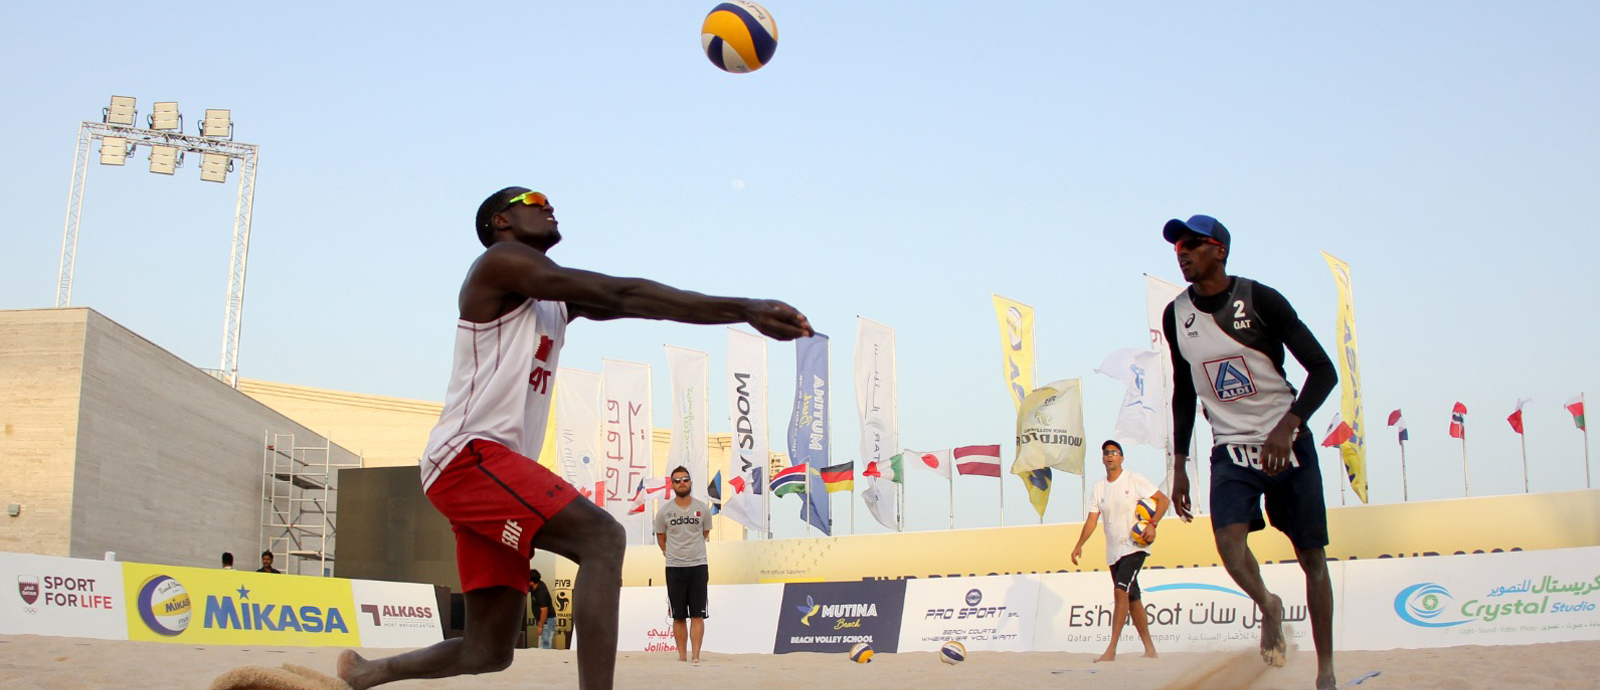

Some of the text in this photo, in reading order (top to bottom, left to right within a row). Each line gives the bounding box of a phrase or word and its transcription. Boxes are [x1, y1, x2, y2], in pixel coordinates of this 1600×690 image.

[1233, 300, 1246, 318] 2
[1233, 319, 1251, 330] QAT
[1222, 386, 1251, 399] ALDI
[670, 516, 700, 526] adidas
[43, 576, 96, 592] SPORT
[554, 579, 571, 588] FIVB
[1486, 579, 1532, 598] للتصوير
[45, 592, 113, 609] FOR LIFE
[203, 594, 350, 633] MIKASA
[382, 605, 433, 618] ALKASS
[821, 603, 878, 618] MUTINA
[924, 608, 954, 620] PRO
[957, 606, 1007, 619] SPORT
[1189, 602, 1236, 624] سات
[1460, 595, 1596, 622] Crystal Studio
[833, 618, 861, 630] Beach
[842, 635, 873, 643] SCHOOL
[1067, 634, 1092, 642] Qatar
